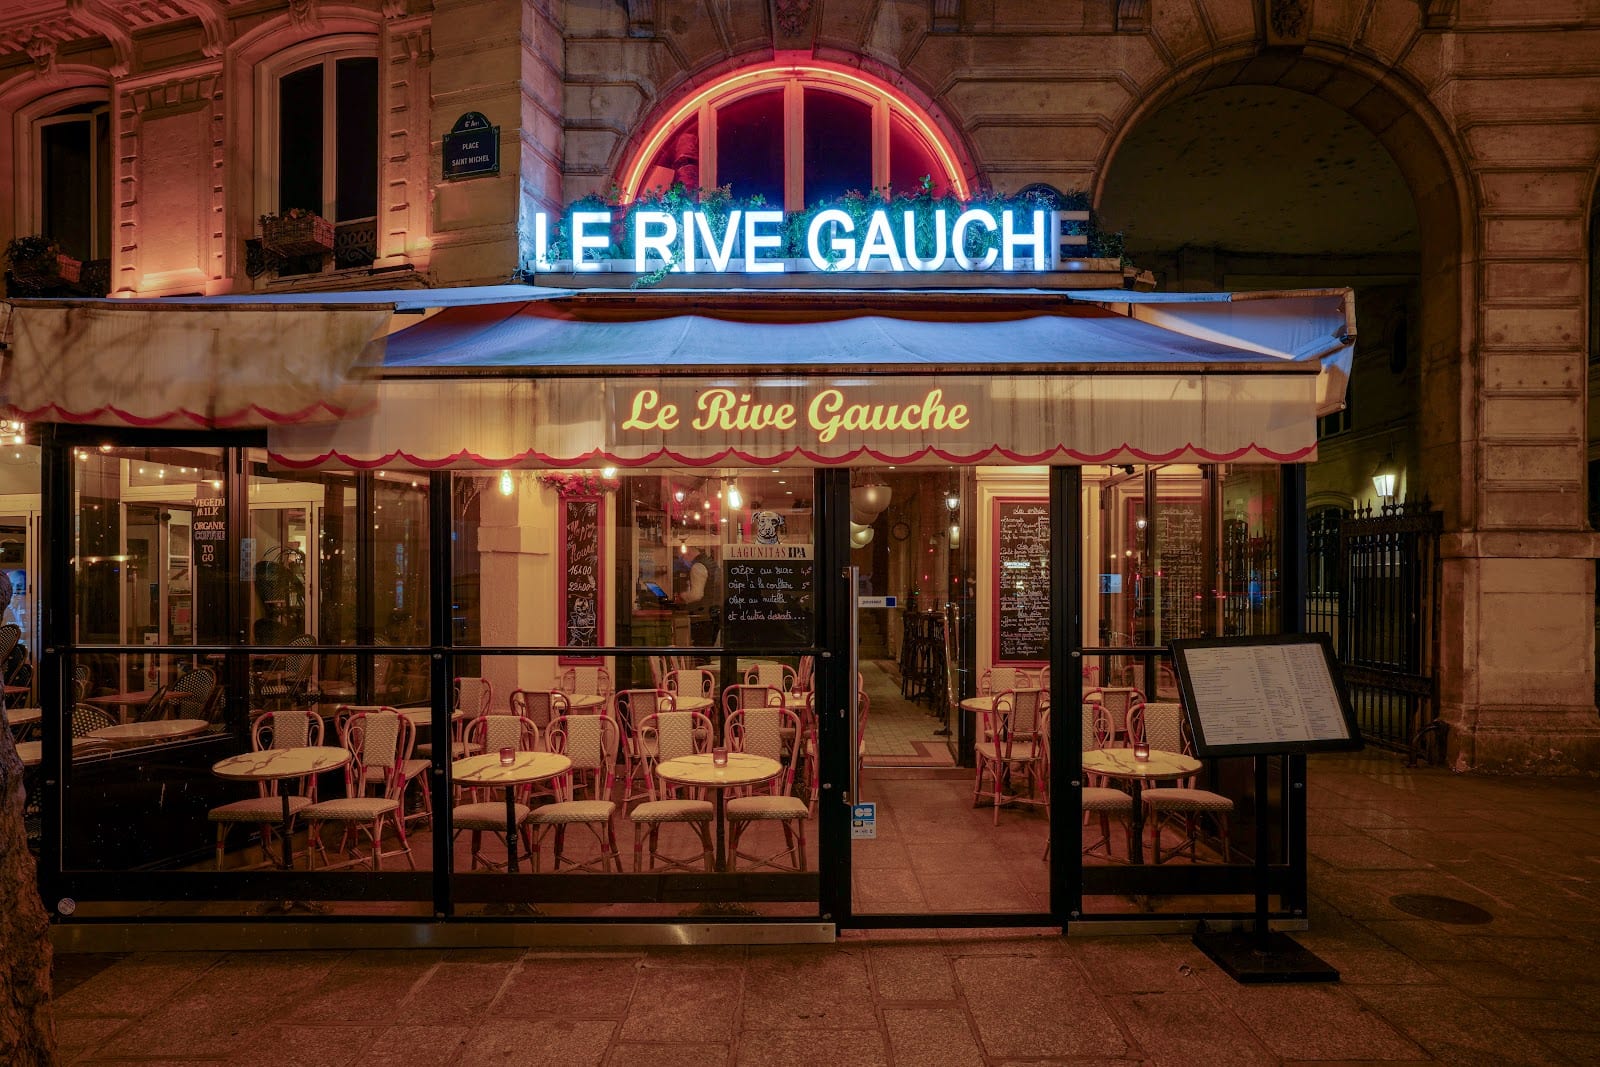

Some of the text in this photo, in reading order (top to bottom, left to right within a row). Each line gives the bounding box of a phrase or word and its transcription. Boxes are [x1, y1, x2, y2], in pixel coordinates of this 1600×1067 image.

[462, 141, 480, 150] PLACE
[451, 154, 490, 167] SAINT MICHEL
[535, 208, 1089, 273] LE RIVE GAUCHE
[621, 388, 970, 444] Le Rive Gauche
[197, 507, 219, 516] MILK
[193, 521, 226, 531] ORGANIC
[202, 544, 214, 553] TO
[731, 547, 806, 558] LAGUNITAS IPA
[202, 553, 214, 562] GO
[727, 611, 738, 621] et
